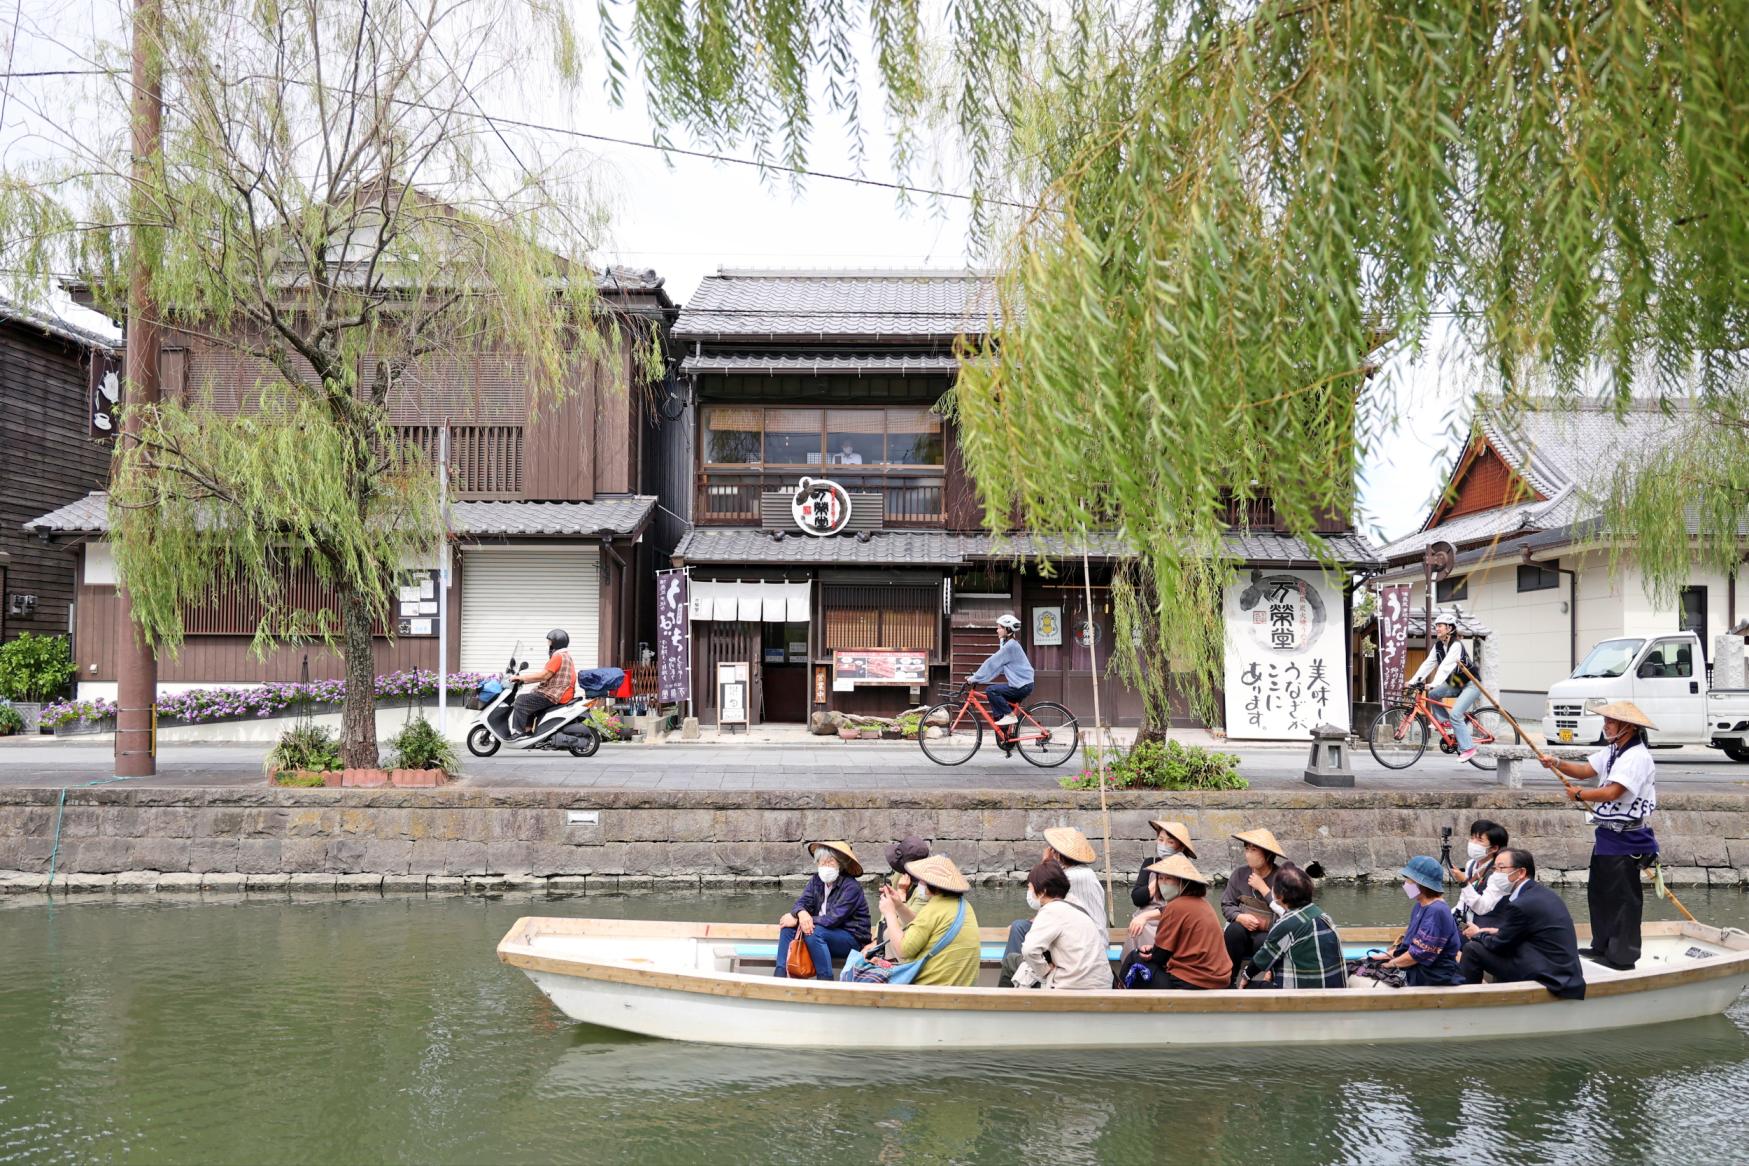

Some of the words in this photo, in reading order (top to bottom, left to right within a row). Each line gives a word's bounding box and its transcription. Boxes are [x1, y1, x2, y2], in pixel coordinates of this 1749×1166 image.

[1270, 581, 1295, 650] 万榮堂
[1384, 593, 1407, 663] うなぎ
[1240, 661, 1267, 730] あります。
[1266, 663, 1283, 712] ここに
[1285, 661, 1307, 730] うなぎが
